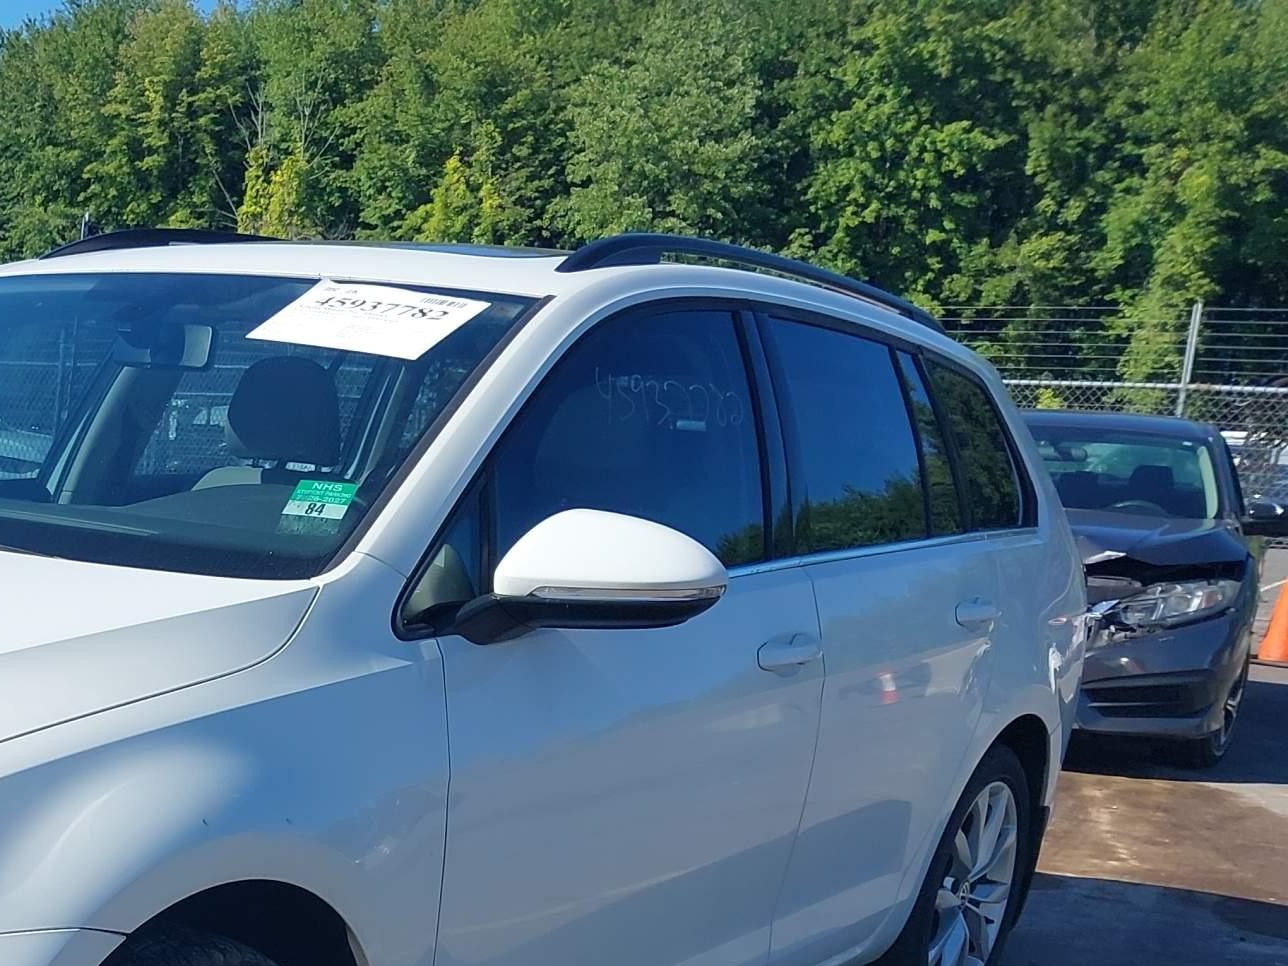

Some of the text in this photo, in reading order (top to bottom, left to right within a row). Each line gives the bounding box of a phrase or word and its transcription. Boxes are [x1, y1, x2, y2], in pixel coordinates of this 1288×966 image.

[315, 296, 449, 320] 45937782
[312, 482, 343, 491] NHS
[305, 502, 326, 516] 84
